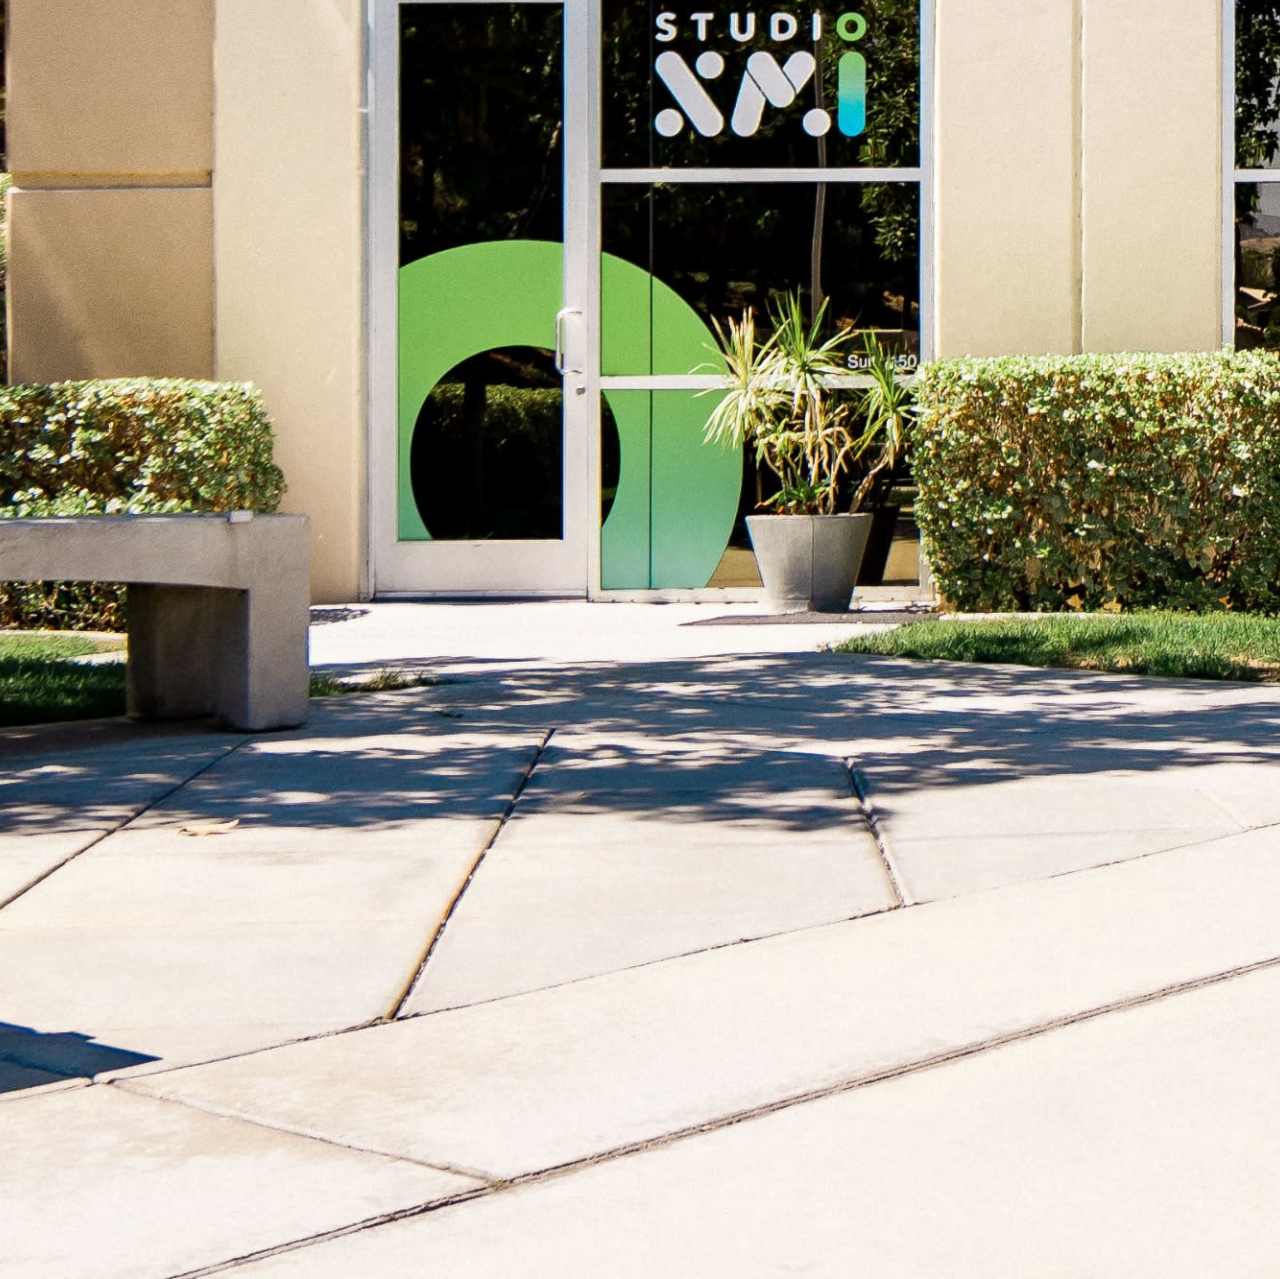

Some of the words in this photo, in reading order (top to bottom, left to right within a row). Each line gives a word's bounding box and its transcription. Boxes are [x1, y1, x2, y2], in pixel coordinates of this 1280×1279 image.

[655, 12, 867, 42] STUDIO
[847, 354, 875, 368] Sui
[891, 354, 917, 368] 50
